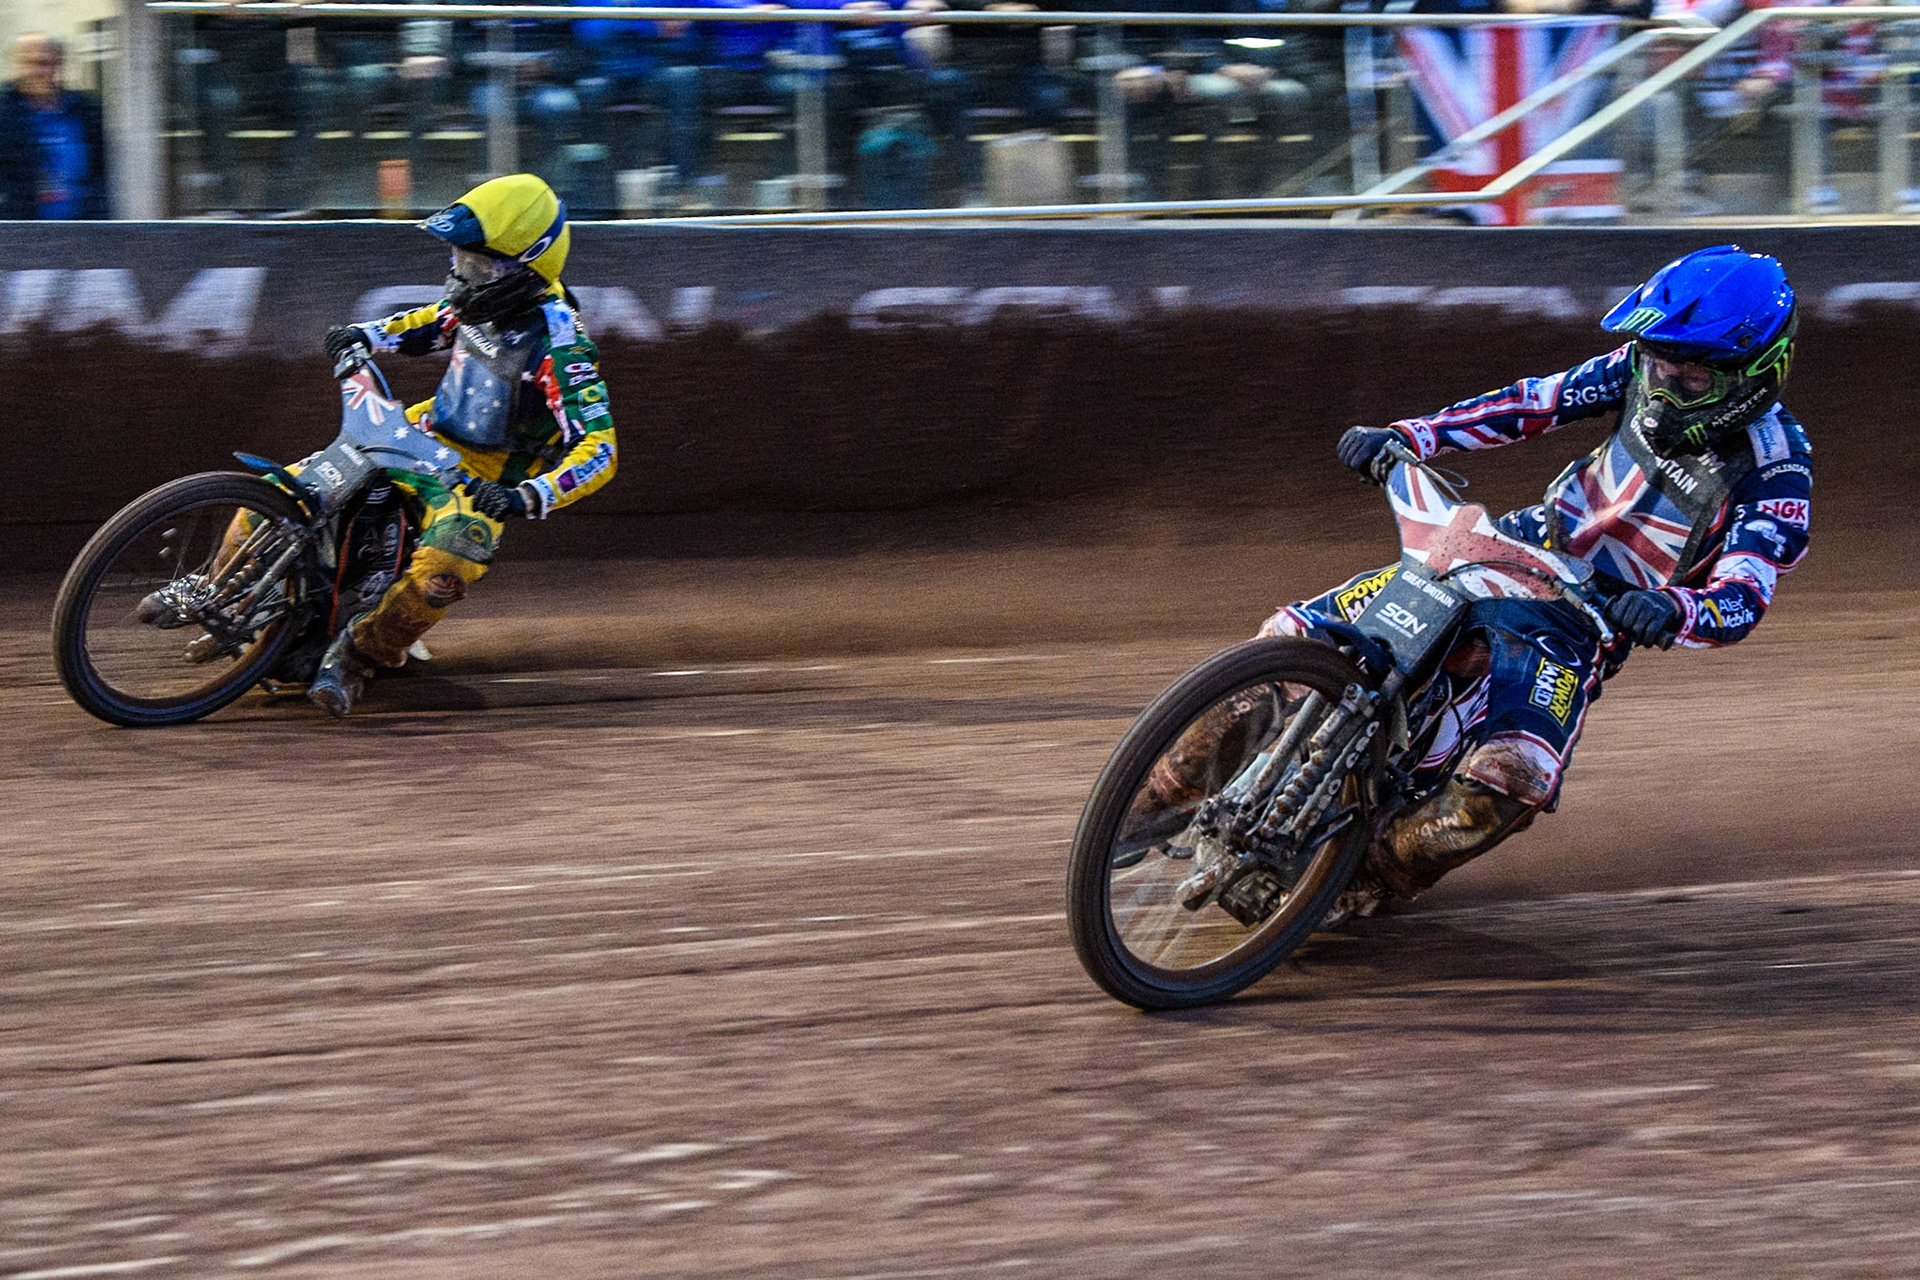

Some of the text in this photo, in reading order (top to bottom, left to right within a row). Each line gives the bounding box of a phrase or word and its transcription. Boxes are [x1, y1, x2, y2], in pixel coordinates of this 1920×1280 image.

[1562, 385, 1598, 407] SRG
[1655, 456, 1699, 495] ITAIN
[1762, 500, 1807, 521] NGK
[1340, 567, 1398, 608] POW
[1401, 570, 1455, 608] GREAT BRITAIN
[1380, 602, 1428, 635] SON
[1534, 661, 1561, 707] MAXED
[1549, 668, 1575, 718] POWER
